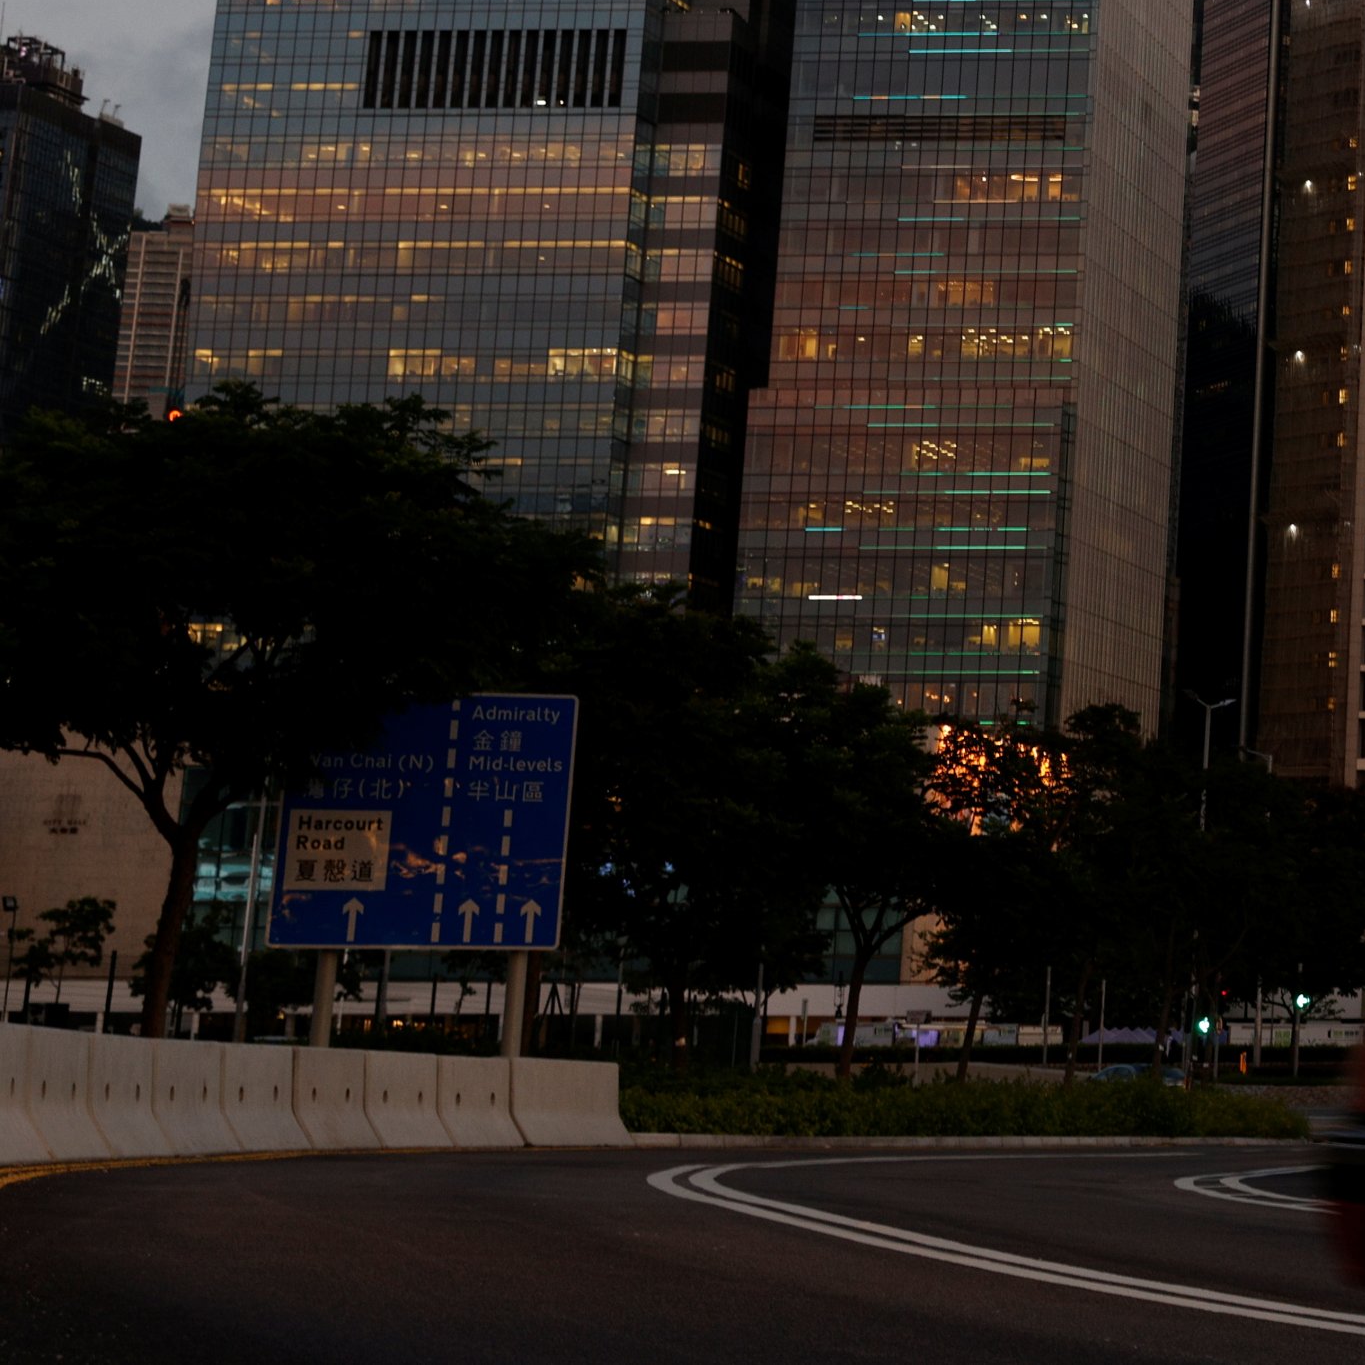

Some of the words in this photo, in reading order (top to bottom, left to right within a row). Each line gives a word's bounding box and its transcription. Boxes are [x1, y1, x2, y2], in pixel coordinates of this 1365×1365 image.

[471, 704, 561, 725] Admiralty
[472, 729, 525, 753] 金鐘
[350, 752, 392, 770] Chai
[399, 754, 433, 774] (N)
[468, 755, 564, 773] Mid-levels
[467, 778, 546, 803] 半山區
[297, 815, 384, 831] Harcourt
[295, 835, 345, 851] Road
